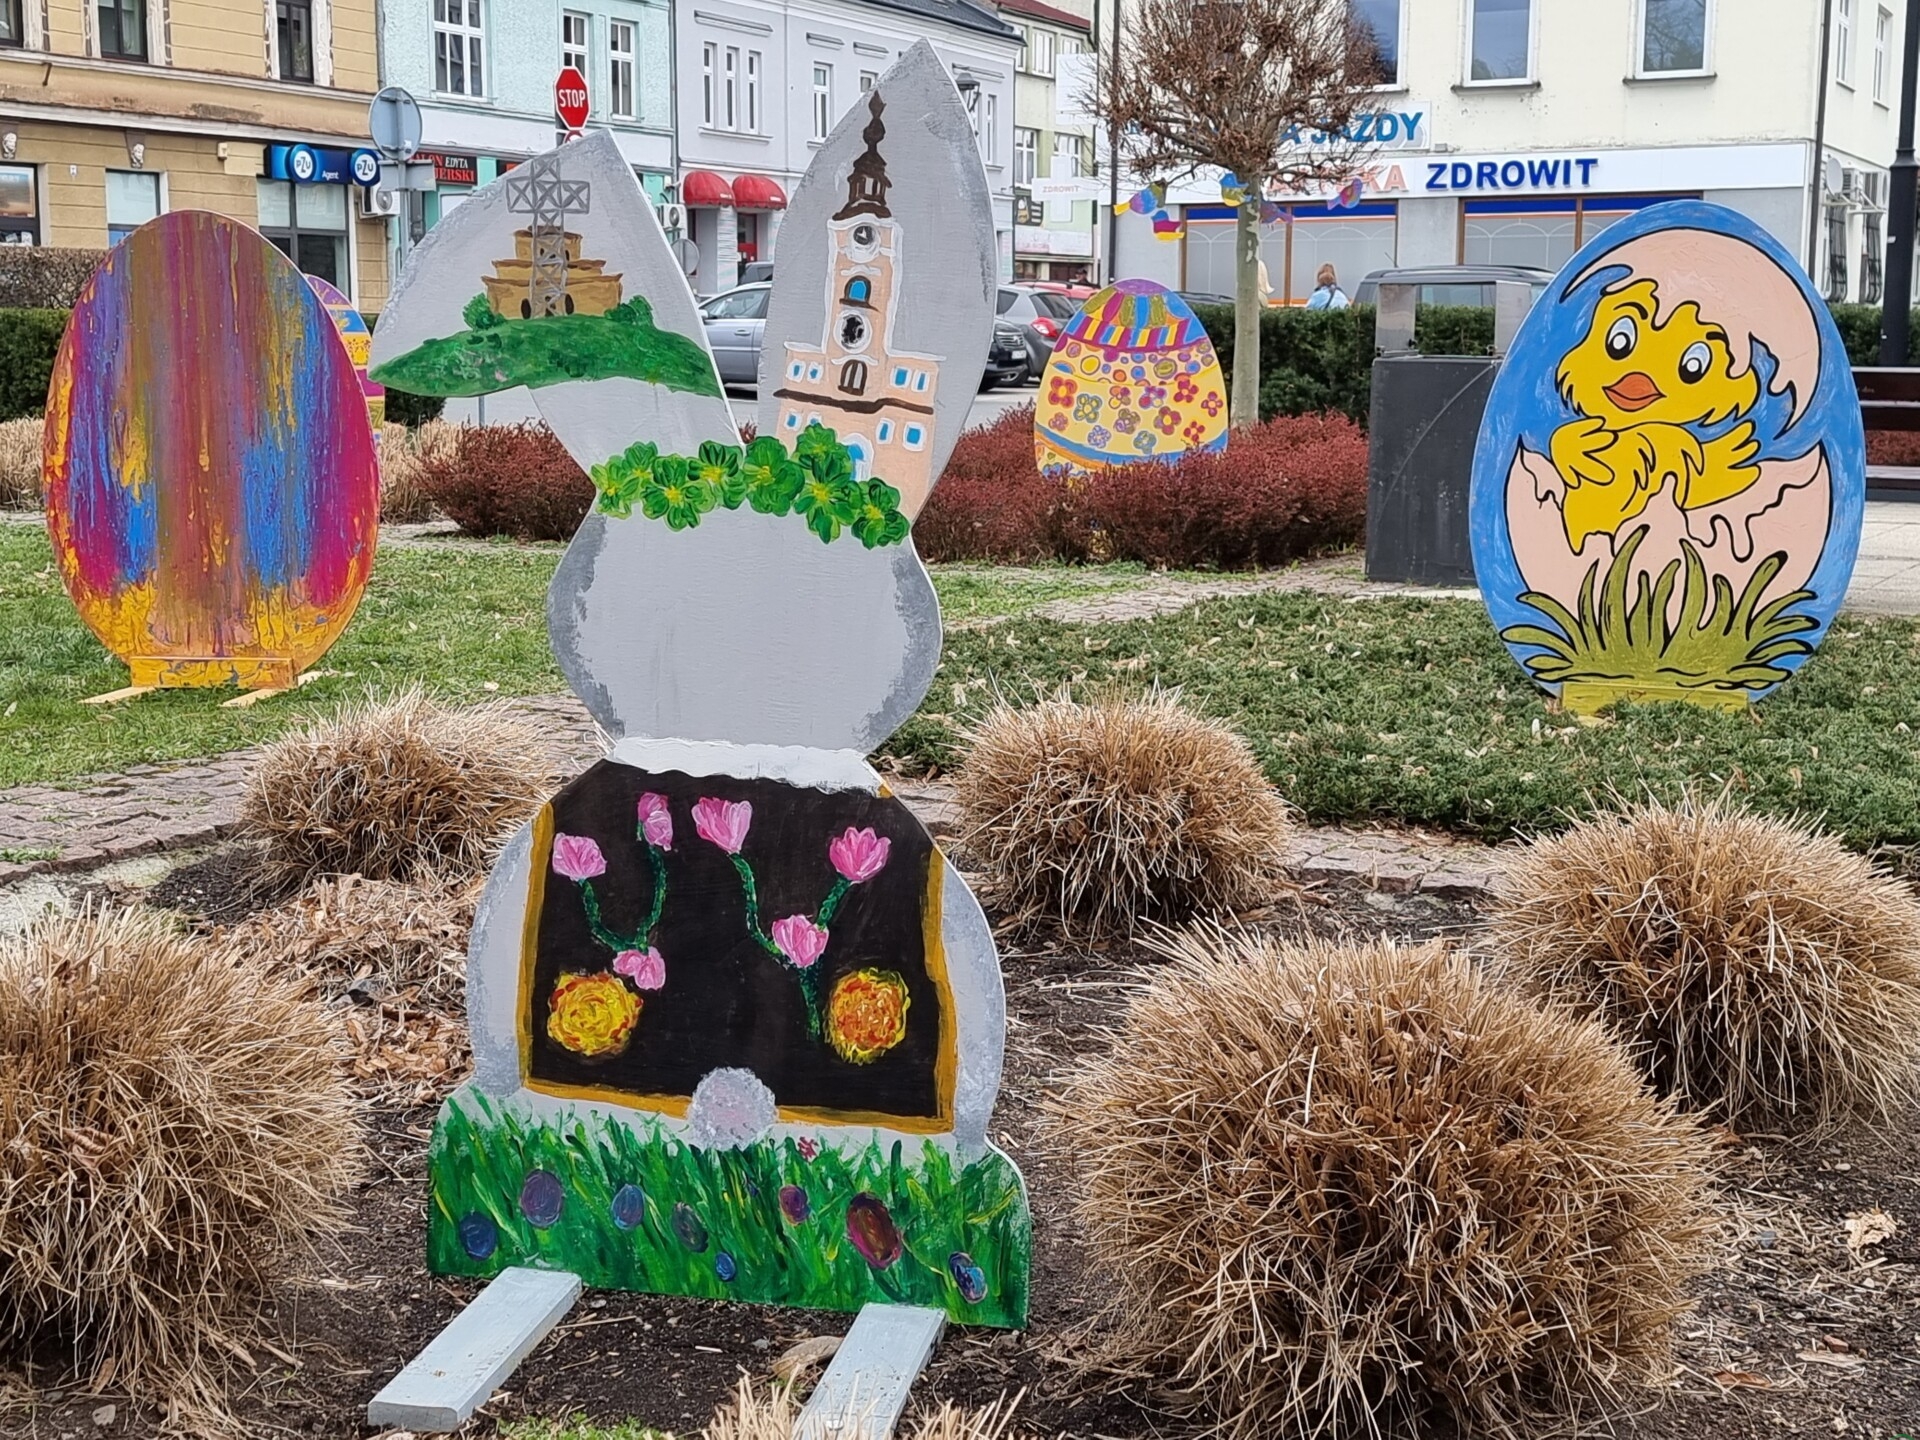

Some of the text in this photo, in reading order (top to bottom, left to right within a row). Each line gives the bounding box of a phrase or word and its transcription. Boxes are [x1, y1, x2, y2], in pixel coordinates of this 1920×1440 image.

[558, 88, 586, 108] STOP
[295, 156, 311, 173] PZU
[356, 159, 374, 176] PZU
[445, 156, 469, 169] EDYTA
[321, 170, 339, 180] Agent
[1425, 158, 1599, 191] ZDROWIT
[1042, 185, 1080, 193] ZDROWIT
